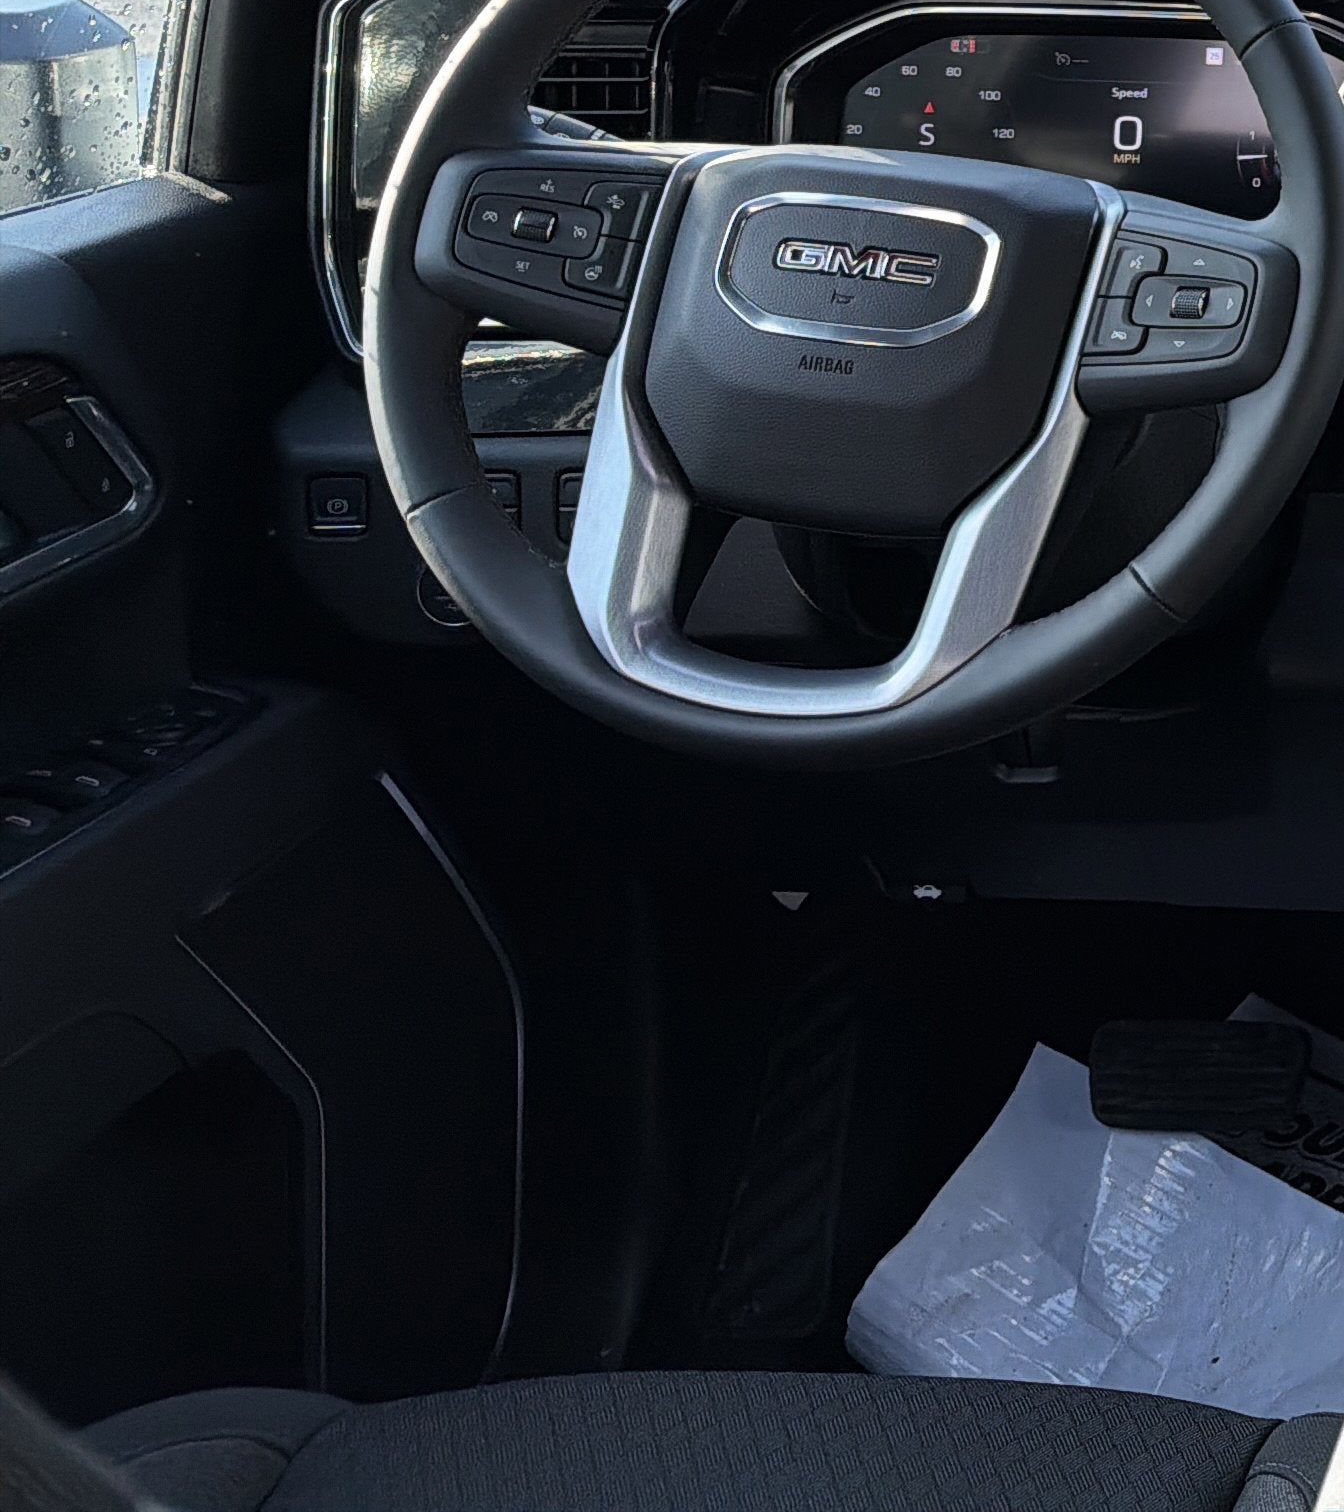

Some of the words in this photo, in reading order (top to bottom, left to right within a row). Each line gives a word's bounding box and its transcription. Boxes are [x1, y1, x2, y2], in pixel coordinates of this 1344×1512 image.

[901, 65, 918, 76] 60
[945, 67, 962, 78] 80
[864, 86, 881, 97] 40
[978, 90, 1001, 101] 100
[1111, 86, 1148, 100] Speed
[846, 124, 863, 135] 20
[918, 123, 935, 146] S
[992, 128, 1015, 139] 120
[1114, 116, 1143, 151] 0
[1113, 153, 1141, 164] MPH
[516, 260, 531, 270] SET
[774, 239, 941, 287] GMC
[798, 354, 855, 376] AIRBAG
